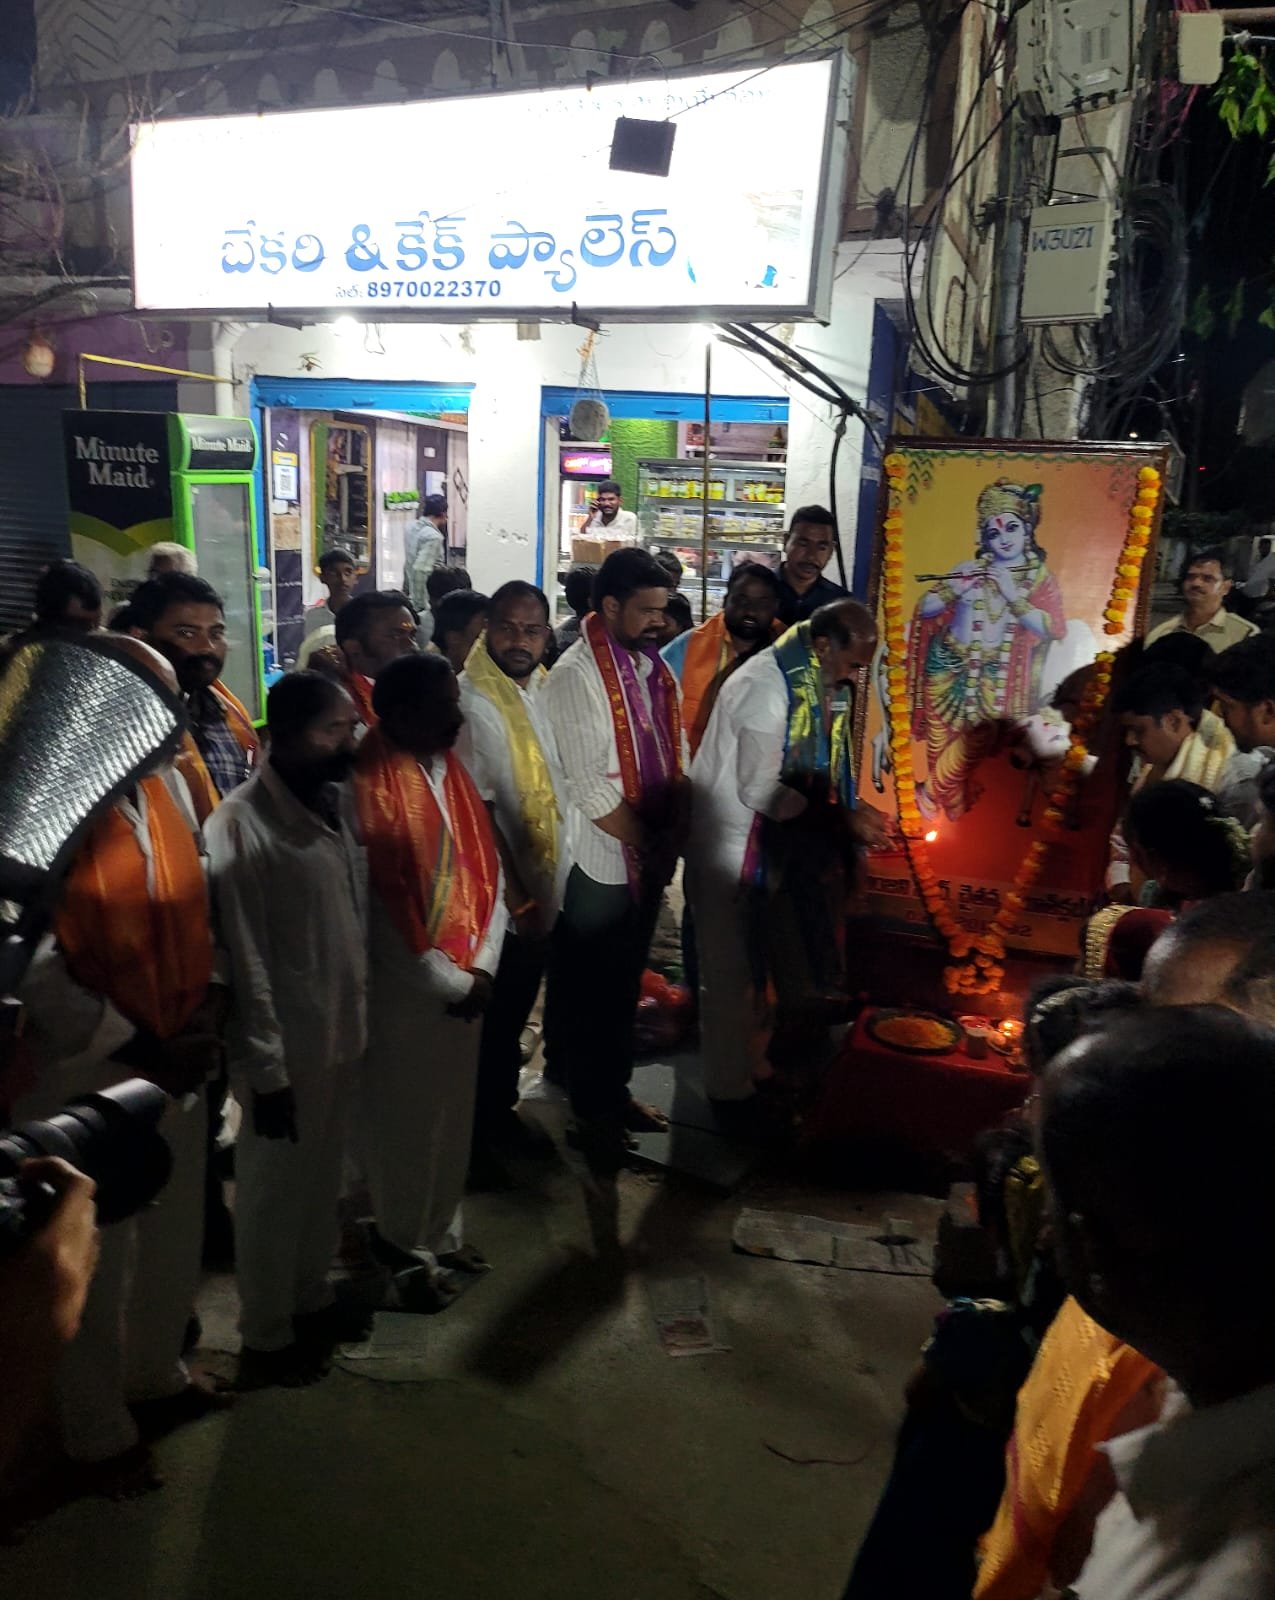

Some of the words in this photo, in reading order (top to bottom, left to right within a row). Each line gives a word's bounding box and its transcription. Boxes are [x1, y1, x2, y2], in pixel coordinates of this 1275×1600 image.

[344, 223, 389, 272] &
[488, 208, 678, 292] ప్యాలెస్
[367, 280, 502, 298] 8970022370
[74, 435, 160, 464] Minute
